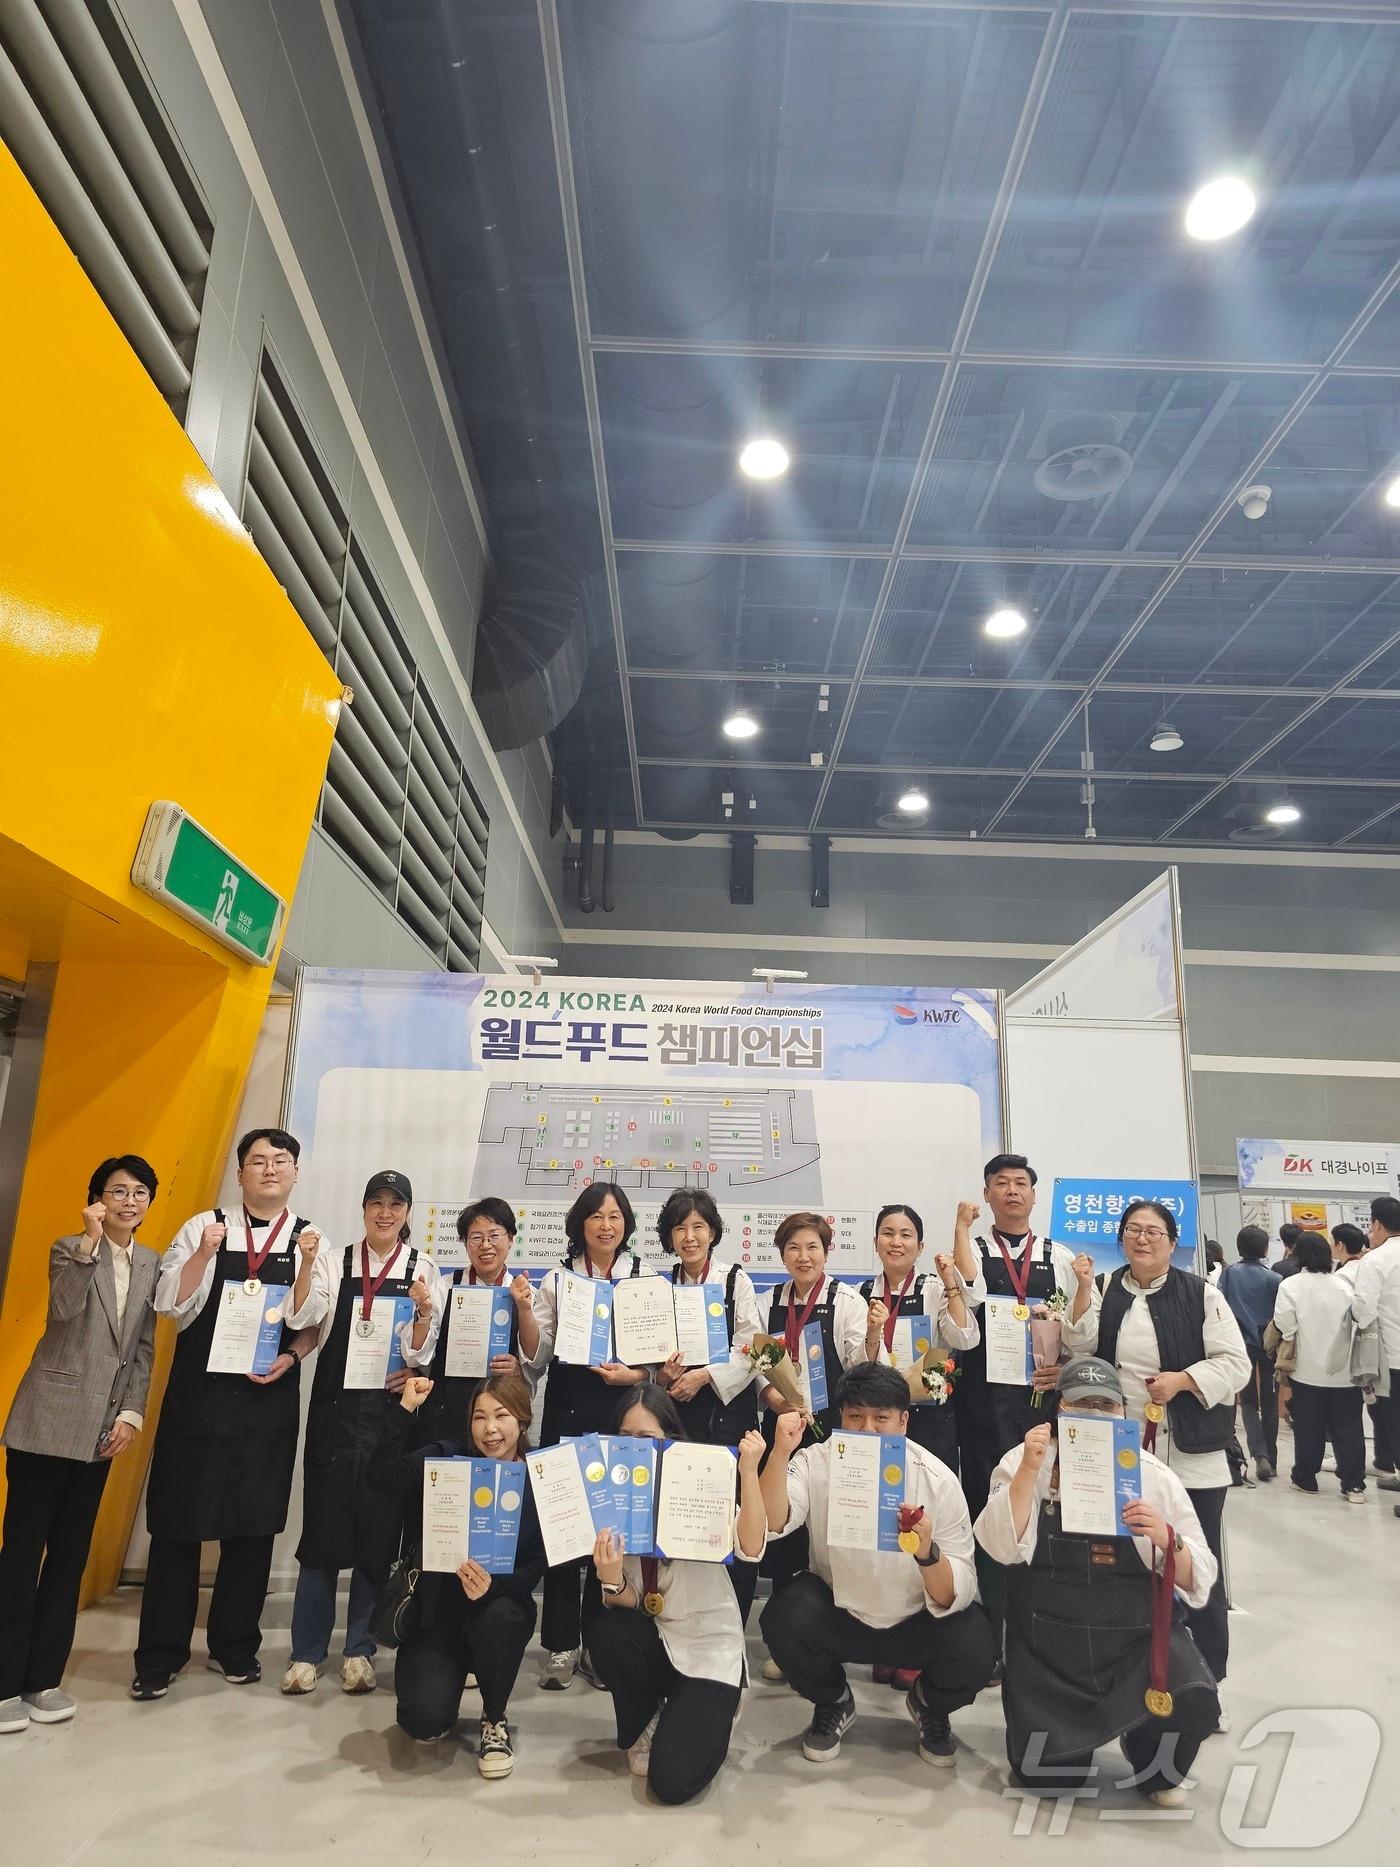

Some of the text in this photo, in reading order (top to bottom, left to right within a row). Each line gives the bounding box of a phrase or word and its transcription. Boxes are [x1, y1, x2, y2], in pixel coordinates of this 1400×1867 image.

[483, 989, 647, 1013] 2024 KOREA
[651, 1003, 822, 1019] 2024 Korea World Food Championships
[923, 1008, 962, 1024] KWFC
[480, 1017, 823, 1069] 월드푸드 챔피언십
[1283, 1158, 1314, 1173] DK
[1321, 1159, 1388, 1175] 대경나이프
[1063, 1220, 1098, 1233] 수출입
